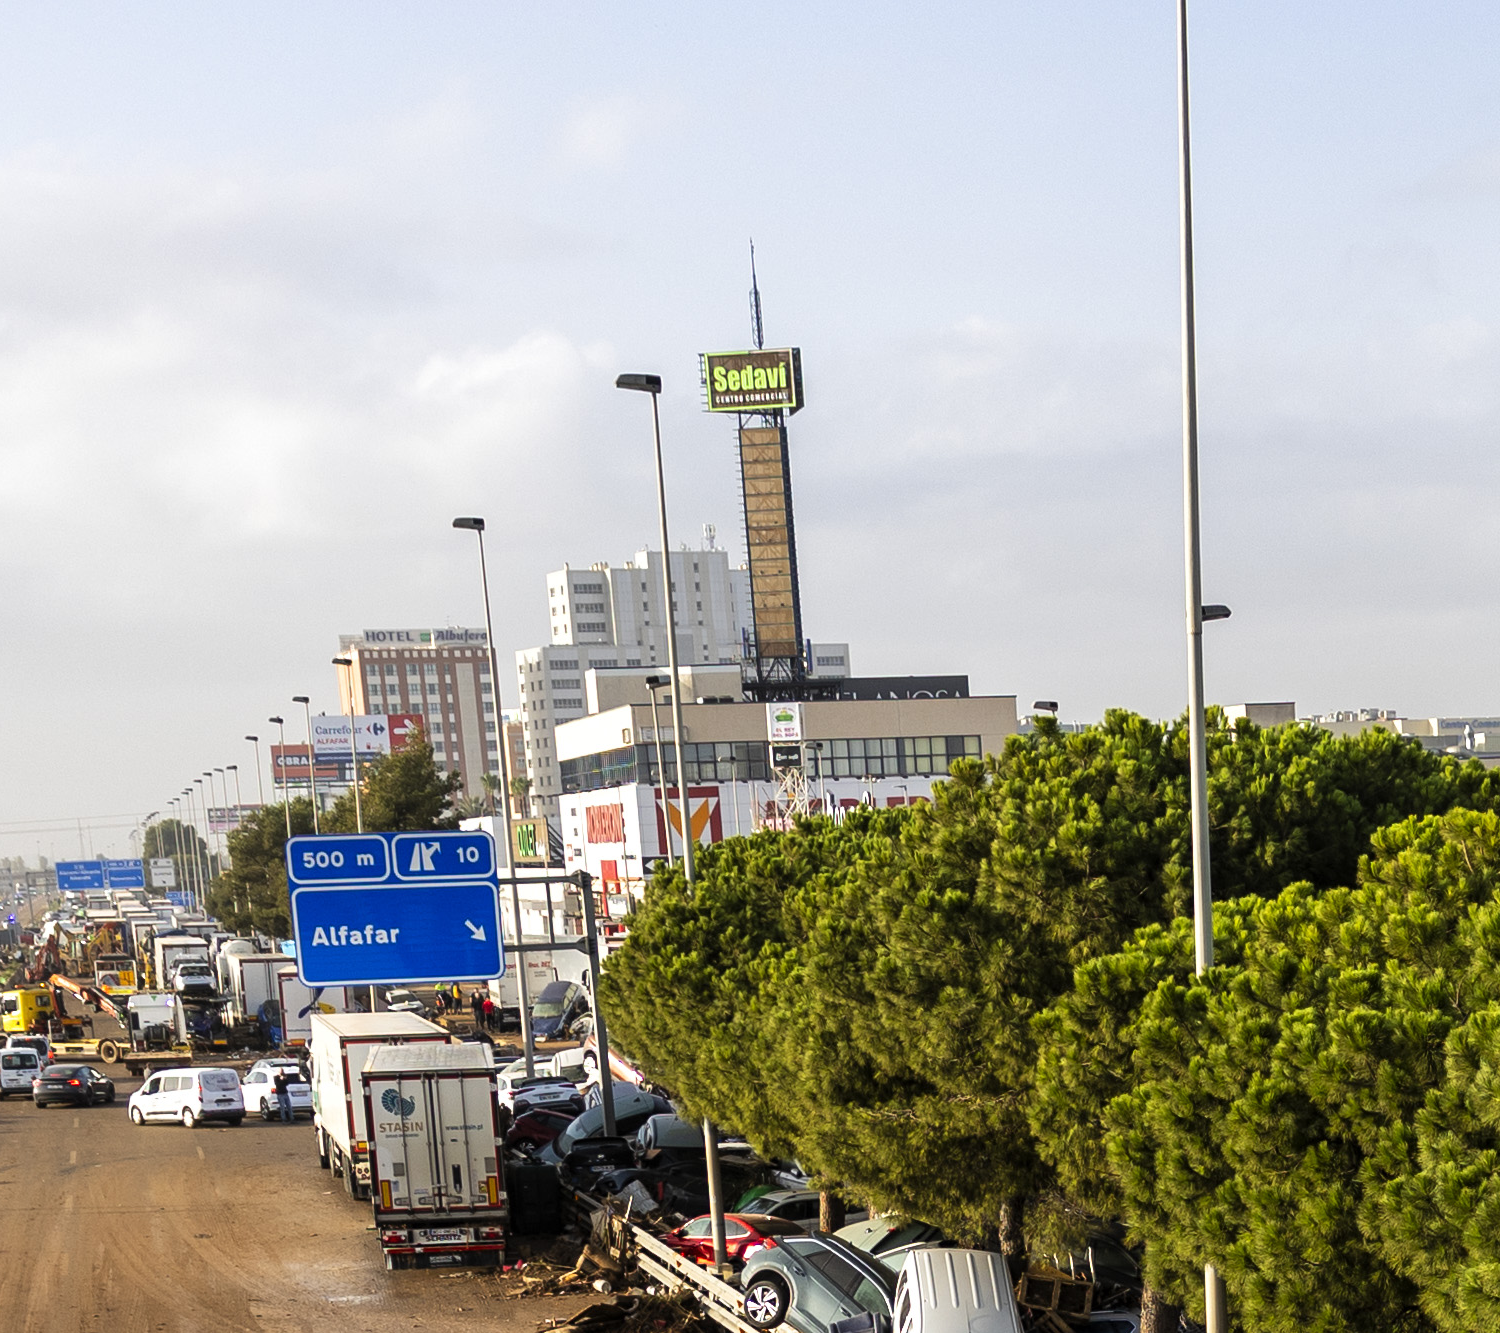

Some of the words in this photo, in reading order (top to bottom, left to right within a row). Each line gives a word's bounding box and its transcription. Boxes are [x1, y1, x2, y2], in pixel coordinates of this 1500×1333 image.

[713, 361, 787, 392] Sedaví
[716, 394, 744, 404] CENTRO
[365, 631, 414, 642] HOTEL
[435, 629, 487, 643] Albufera
[303, 850, 344, 869] 500
[357, 854, 374, 867] m
[456, 846, 480, 864] 10
[312, 924, 399, 947] Alfafar
[379, 1121, 424, 1133] STASIN
